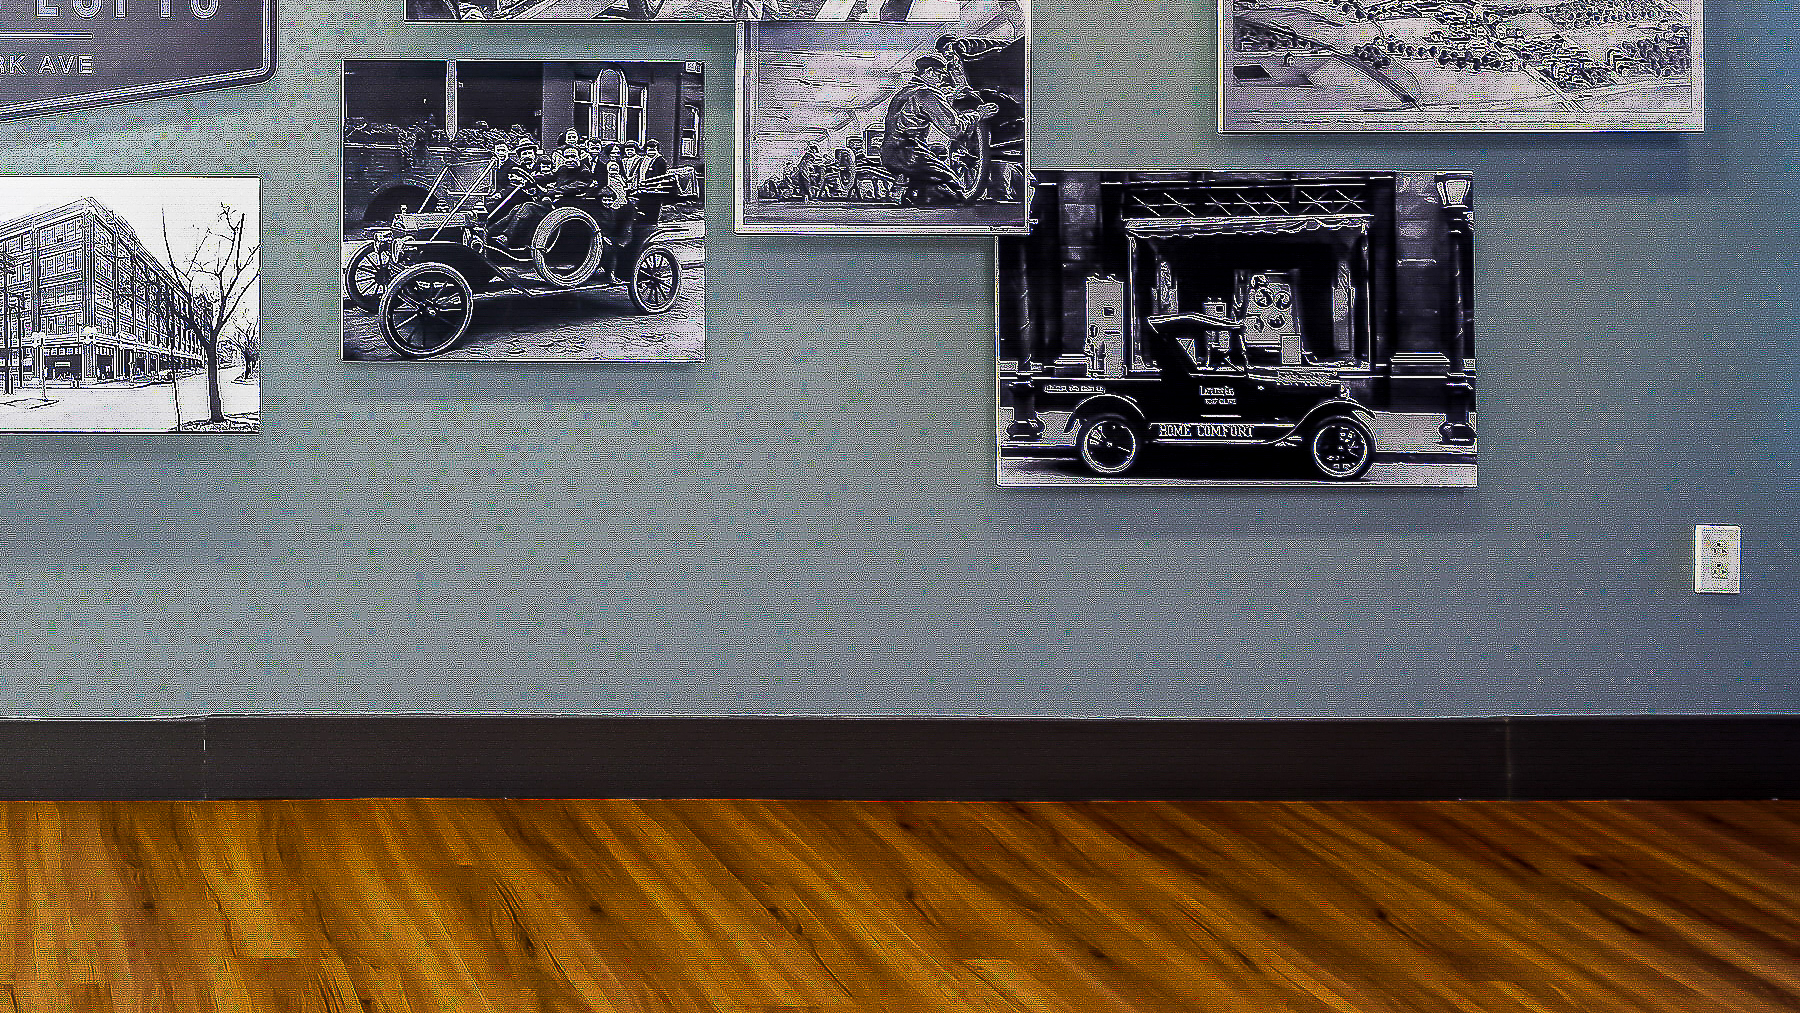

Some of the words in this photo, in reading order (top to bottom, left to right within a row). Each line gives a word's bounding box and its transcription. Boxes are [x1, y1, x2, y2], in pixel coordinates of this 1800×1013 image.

[38, 54, 94, 74] AVE
[1159, 424, 1192, 437] HOME
[1196, 424, 1255, 437] COMFORT
